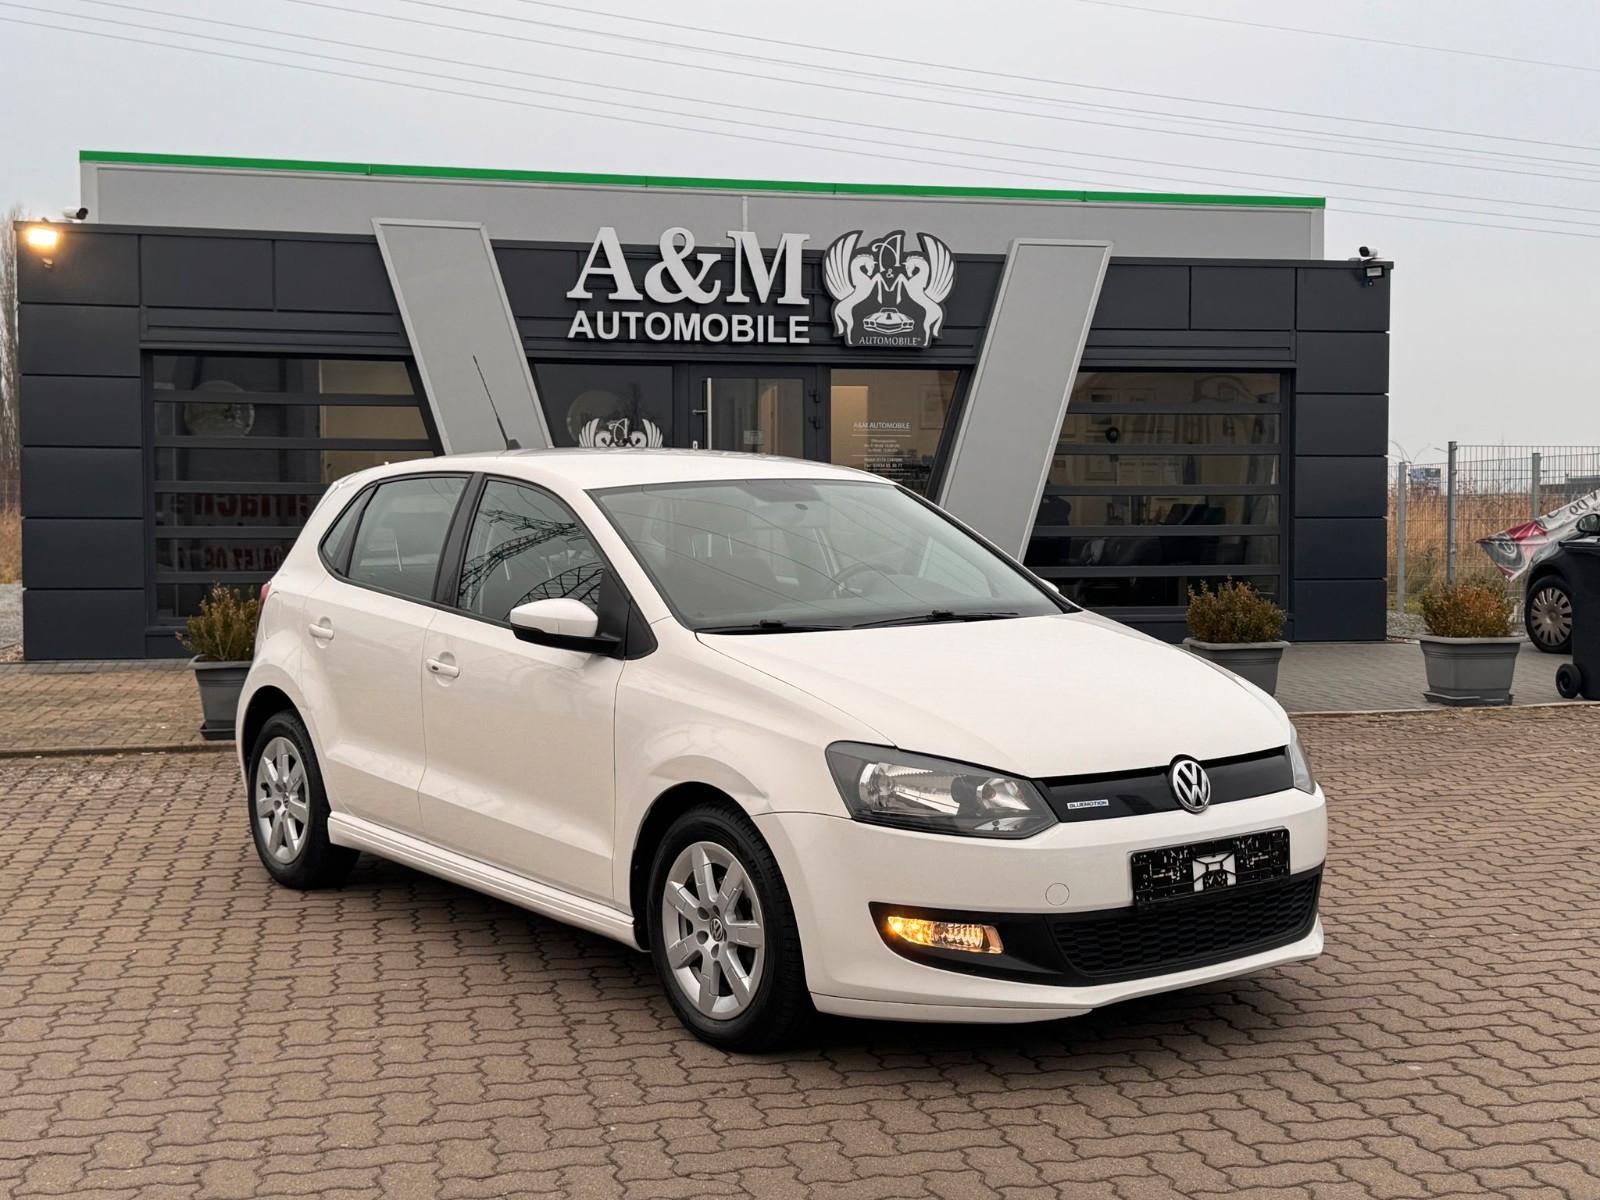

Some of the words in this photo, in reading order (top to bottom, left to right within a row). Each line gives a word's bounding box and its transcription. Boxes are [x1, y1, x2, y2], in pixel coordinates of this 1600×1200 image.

[566, 226, 811, 305] A&M
[567, 310, 811, 344] AUTOMOBILE
[869, 421, 911, 429] AUTOMOBILE
[1069, 799, 1108, 809] BLUEMOTION
